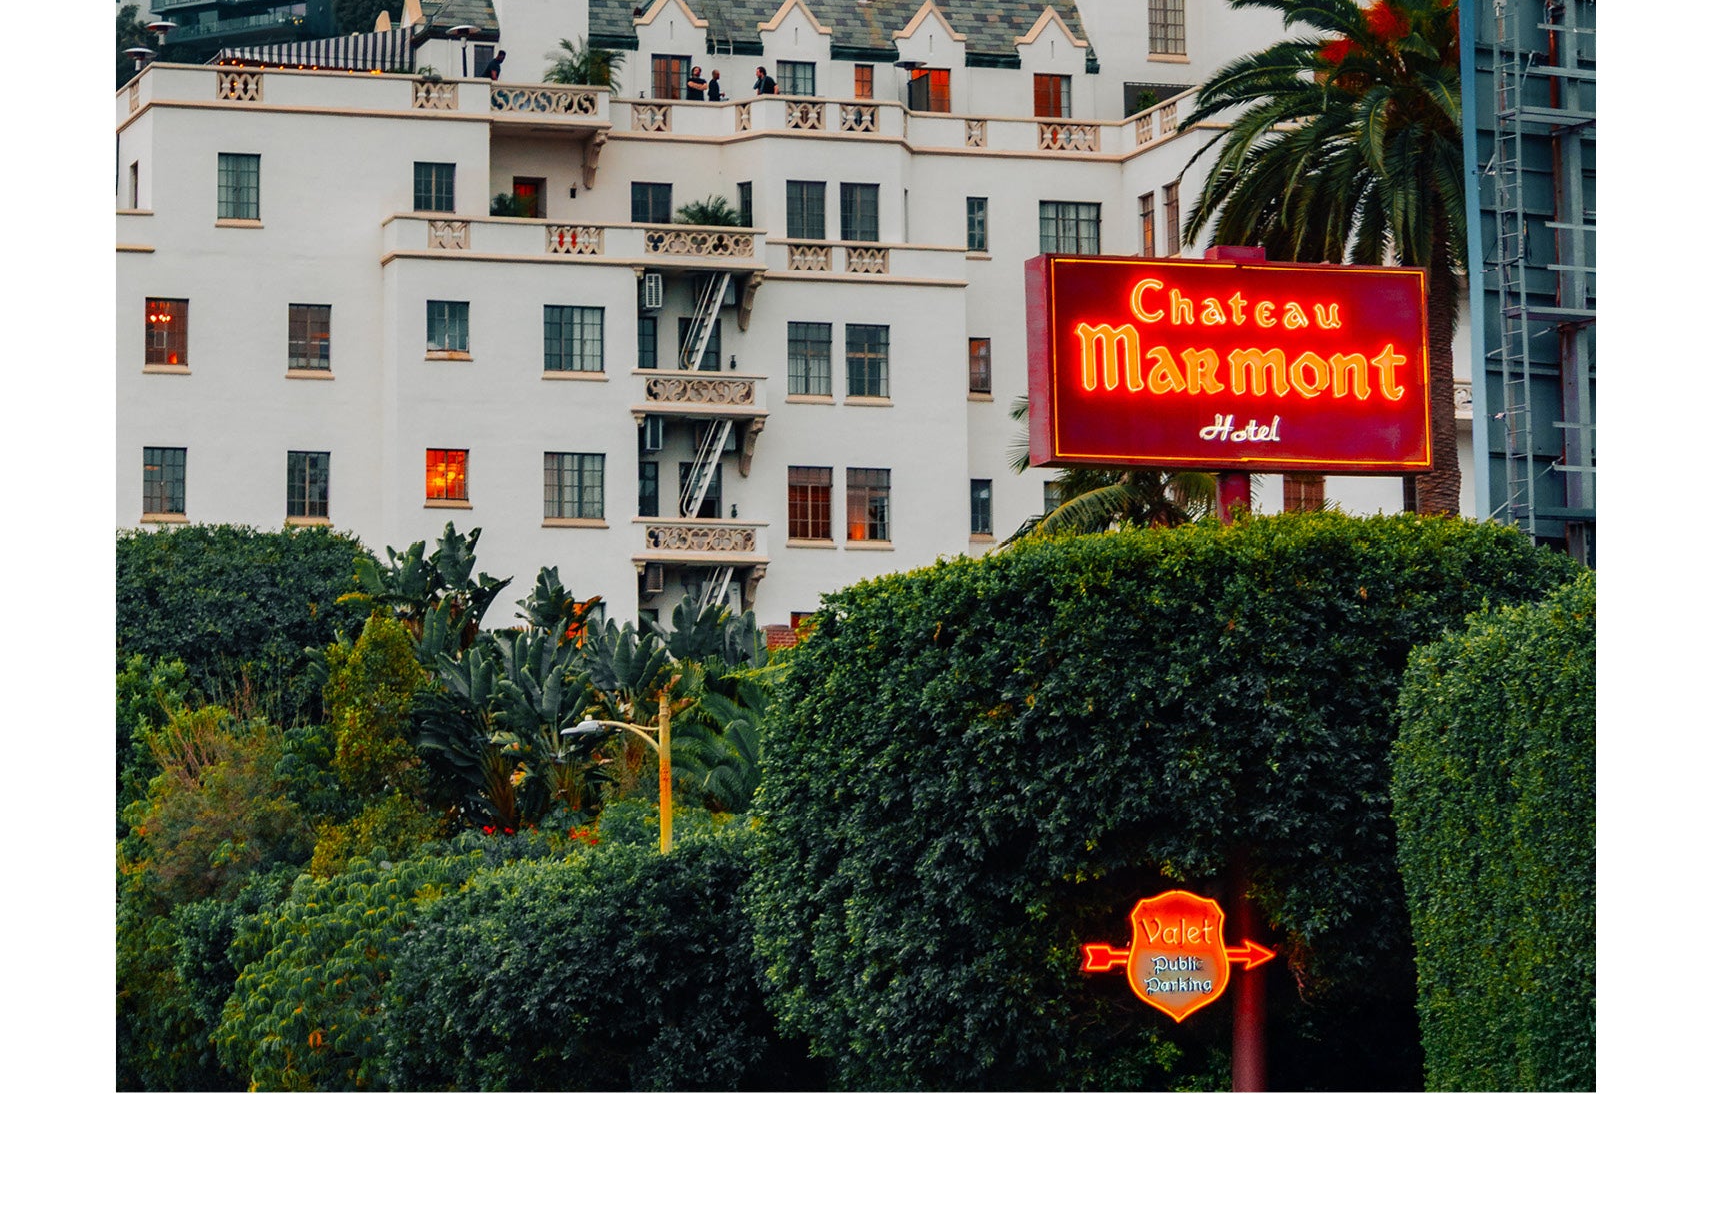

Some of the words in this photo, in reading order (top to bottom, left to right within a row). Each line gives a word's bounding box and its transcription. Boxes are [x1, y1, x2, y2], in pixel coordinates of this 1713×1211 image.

[1130, 278, 1342, 330] Chateau
[1076, 322, 1407, 401] Marmont
[1199, 413, 1281, 442] Hotel
[1141, 917, 1213, 944] Valet
[1144, 977, 1213, 996] Parking
